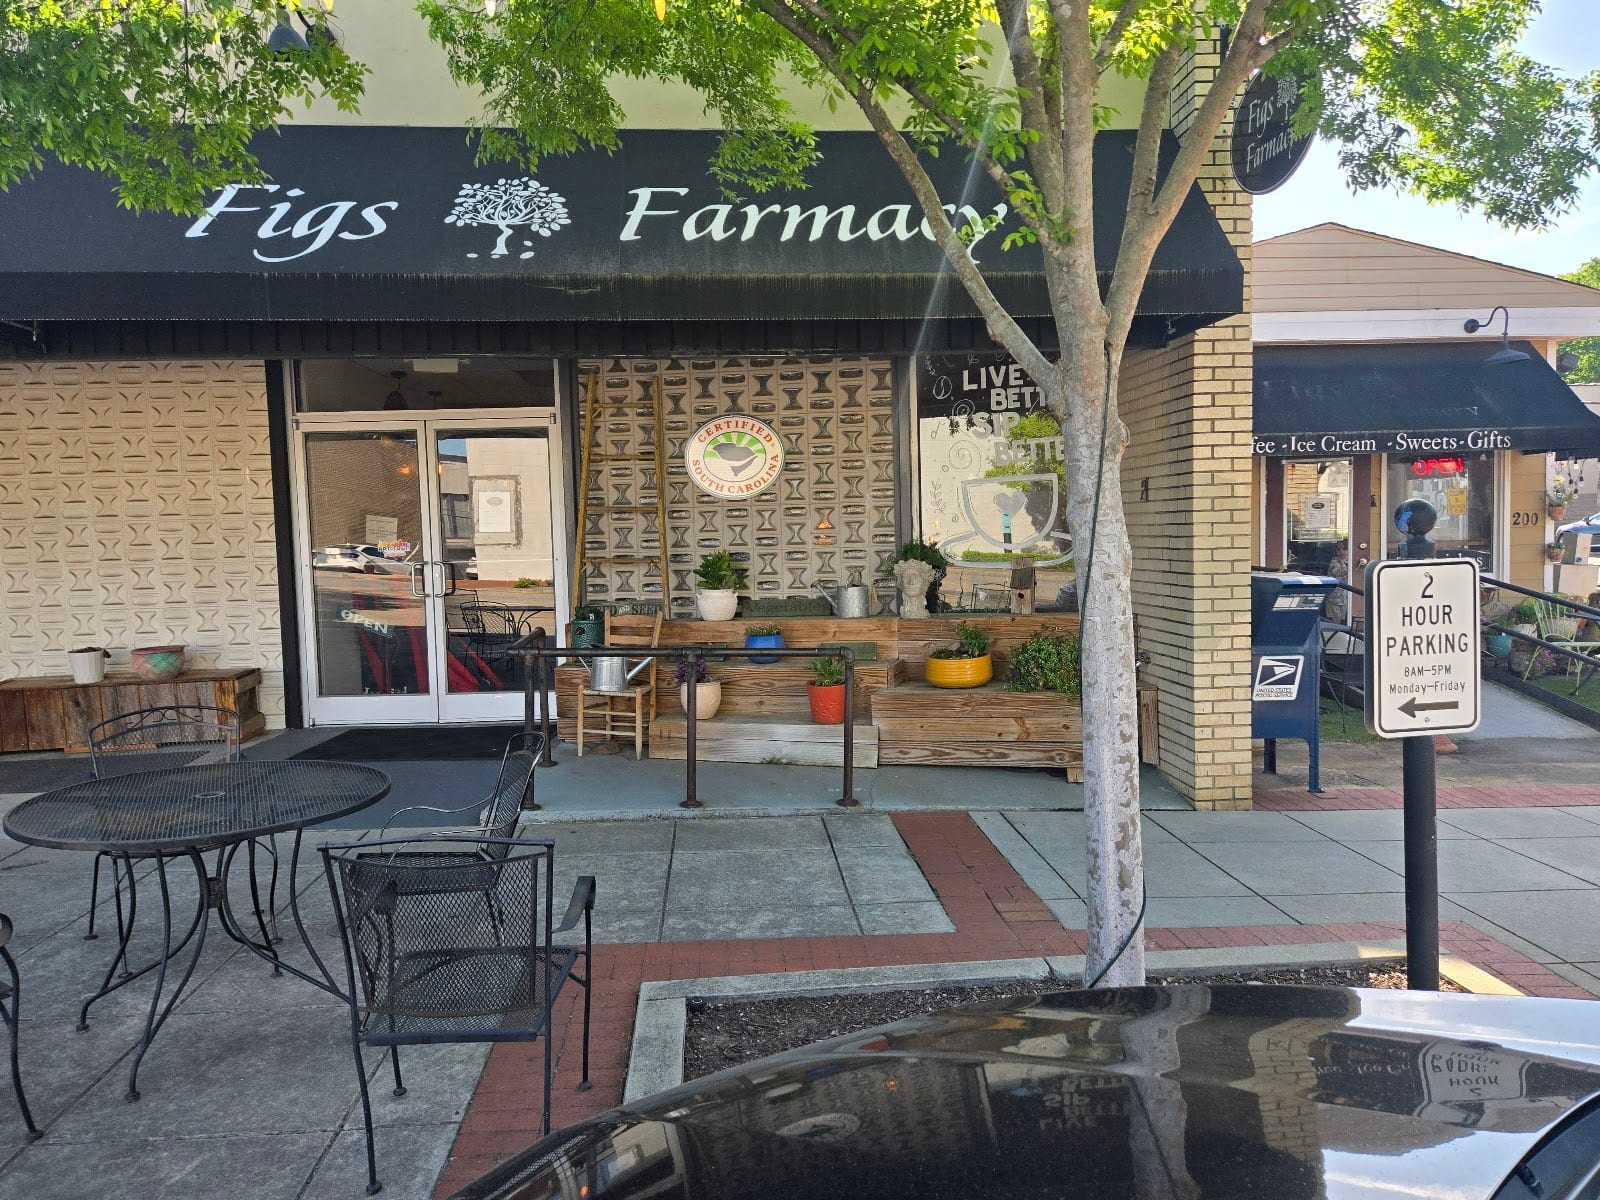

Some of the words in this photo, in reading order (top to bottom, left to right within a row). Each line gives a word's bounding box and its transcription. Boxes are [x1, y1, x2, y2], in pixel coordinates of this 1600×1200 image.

[1247, 96, 1275, 138] Figs
[184, 183, 400, 263] Figs
[962, 364, 1024, 391] LIVE
[697, 419, 774, 444] CERTIFIED
[971, 411, 1021, 440] SIP
[1321, 435, 1377, 452] Cream
[1395, 432, 1457, 451] Sweets
[1467, 429, 1511, 449] Gifts
[692, 458, 725, 493] SOUTH
[727, 453, 779, 494] CAROLINA
[1412, 457, 1465, 477] OPEN
[1511, 511, 1540, 526] 200
[1421, 571, 1434, 599] 2
[340, 608, 389, 635] OPEN
[1401, 604, 1453, 627] HOUR
[1386, 632, 1469, 657] PARKING
